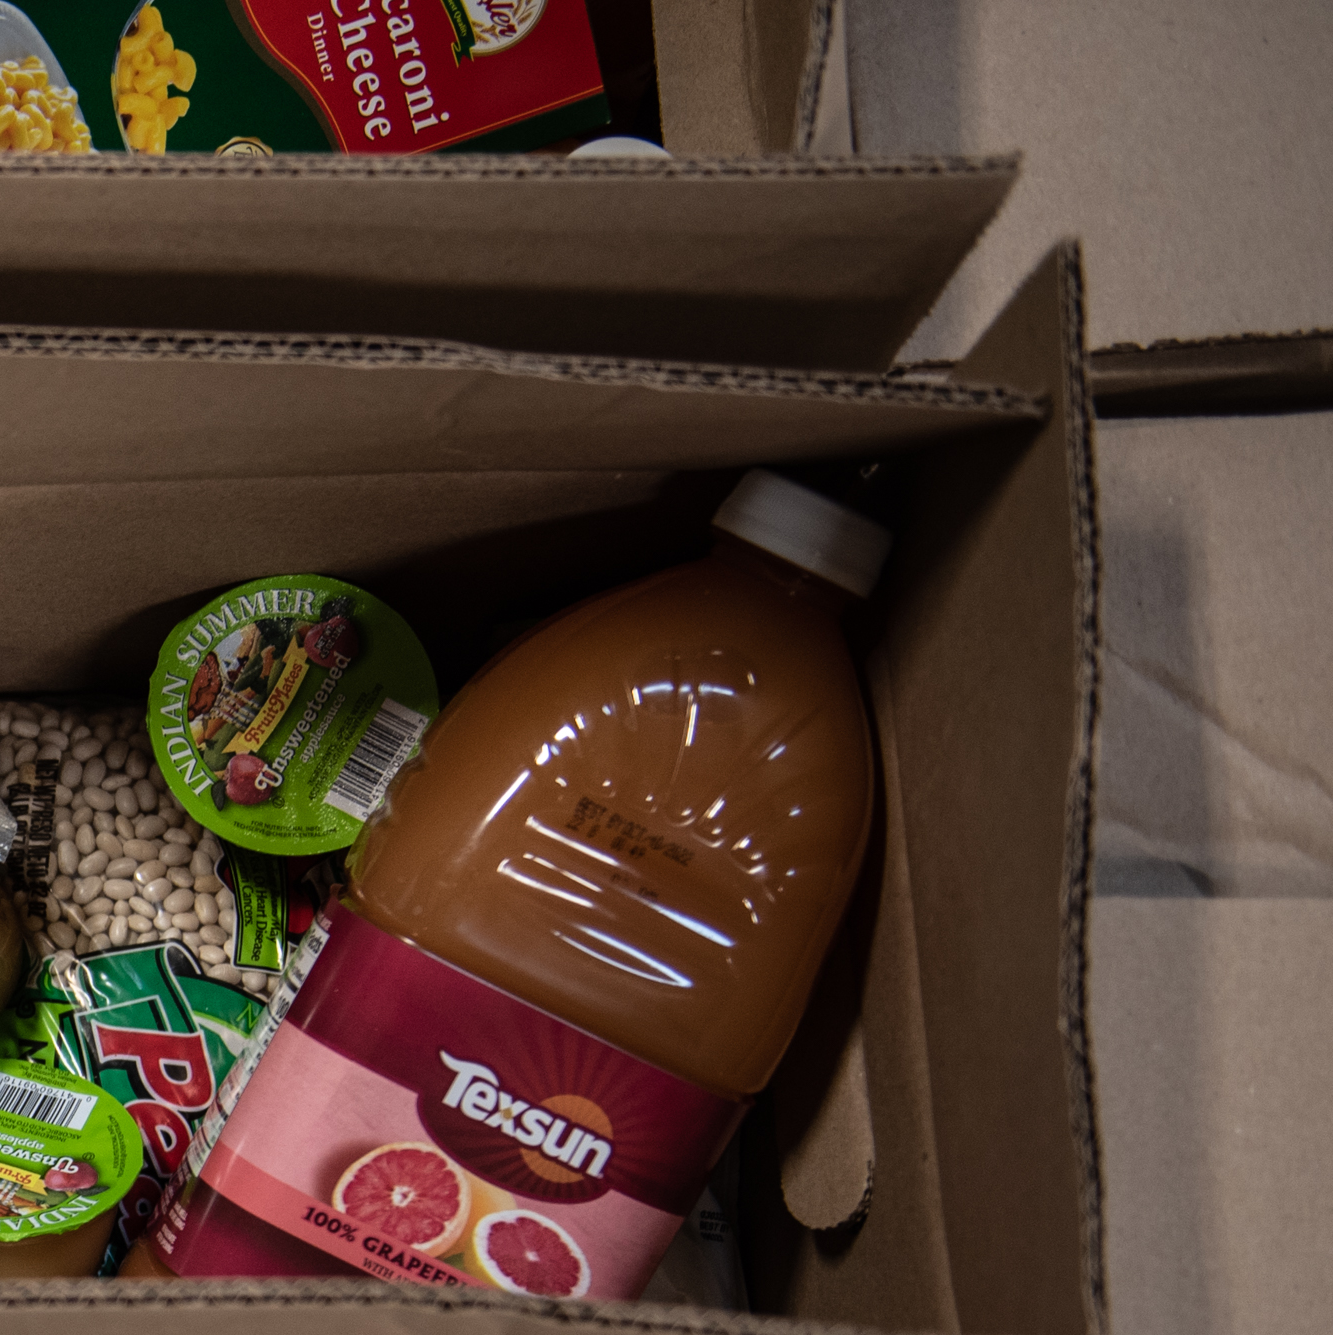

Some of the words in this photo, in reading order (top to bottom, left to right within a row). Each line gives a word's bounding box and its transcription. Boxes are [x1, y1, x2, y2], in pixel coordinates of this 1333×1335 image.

[306, 11, 334, 82] Dinner
[175, 587, 317, 669] SUMMER
[160, 671, 215, 797] INDIAN
[254, 651, 352, 791] Unsweetened
[250, 920, 268, 961] Disease
[255, 889, 268, 918] Heart
[439, 1049, 613, 1179] Texsun
[302, 1205, 360, 1243] 100%
